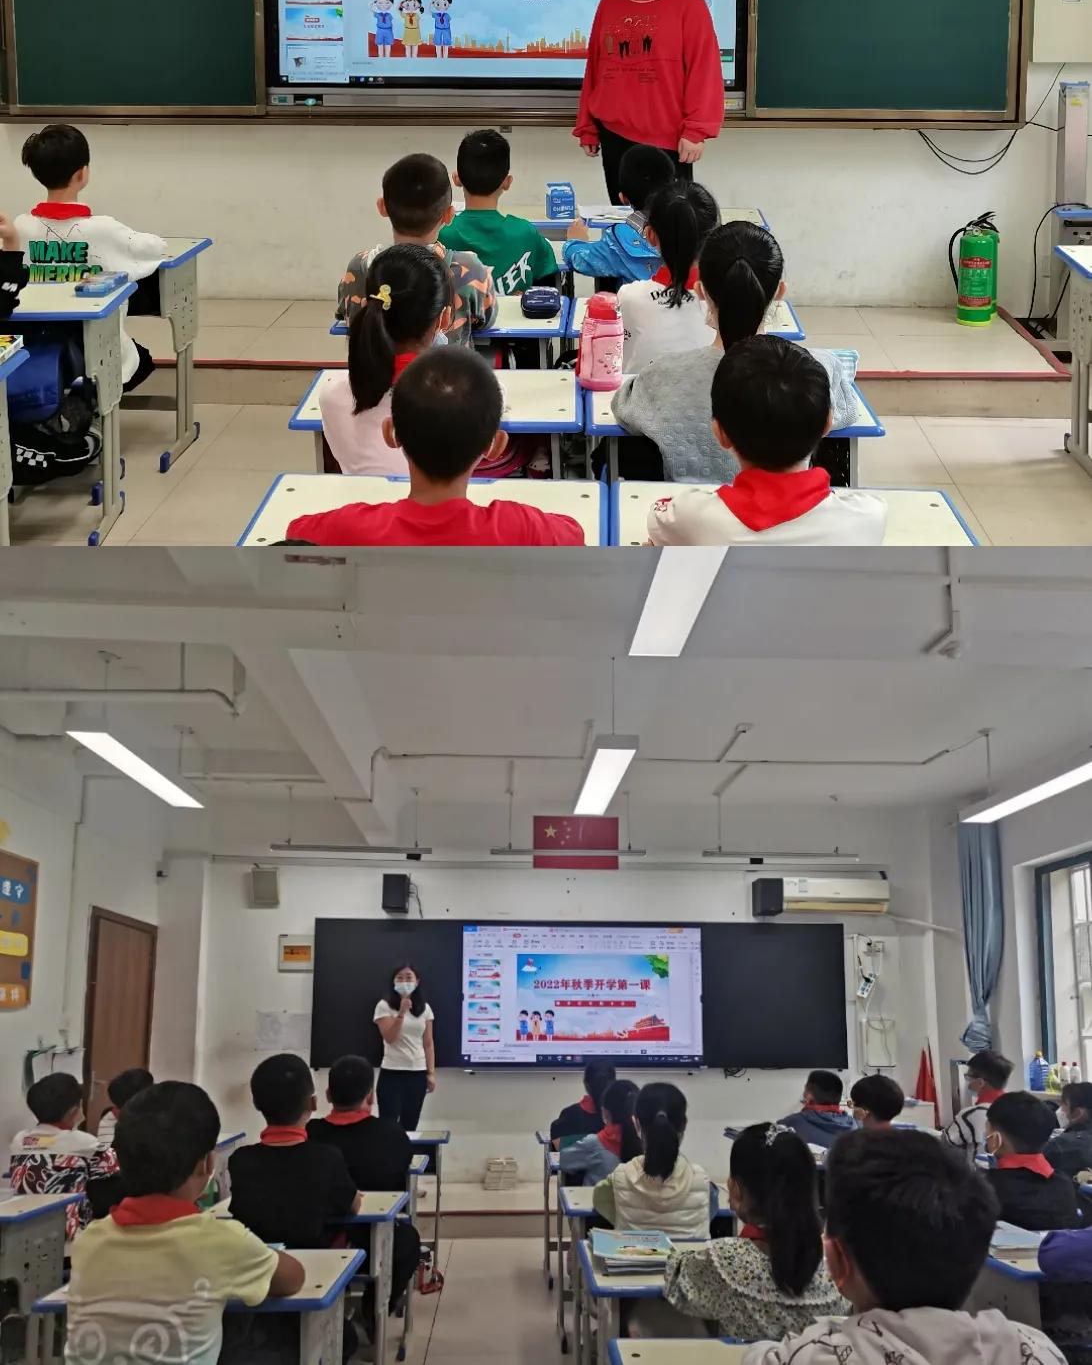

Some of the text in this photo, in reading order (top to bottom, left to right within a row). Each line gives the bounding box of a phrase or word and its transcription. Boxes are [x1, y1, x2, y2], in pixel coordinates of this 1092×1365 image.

[29, 240, 88, 263] MAKE
[534, 978, 651, 990] 2022年秋季开学第一课
